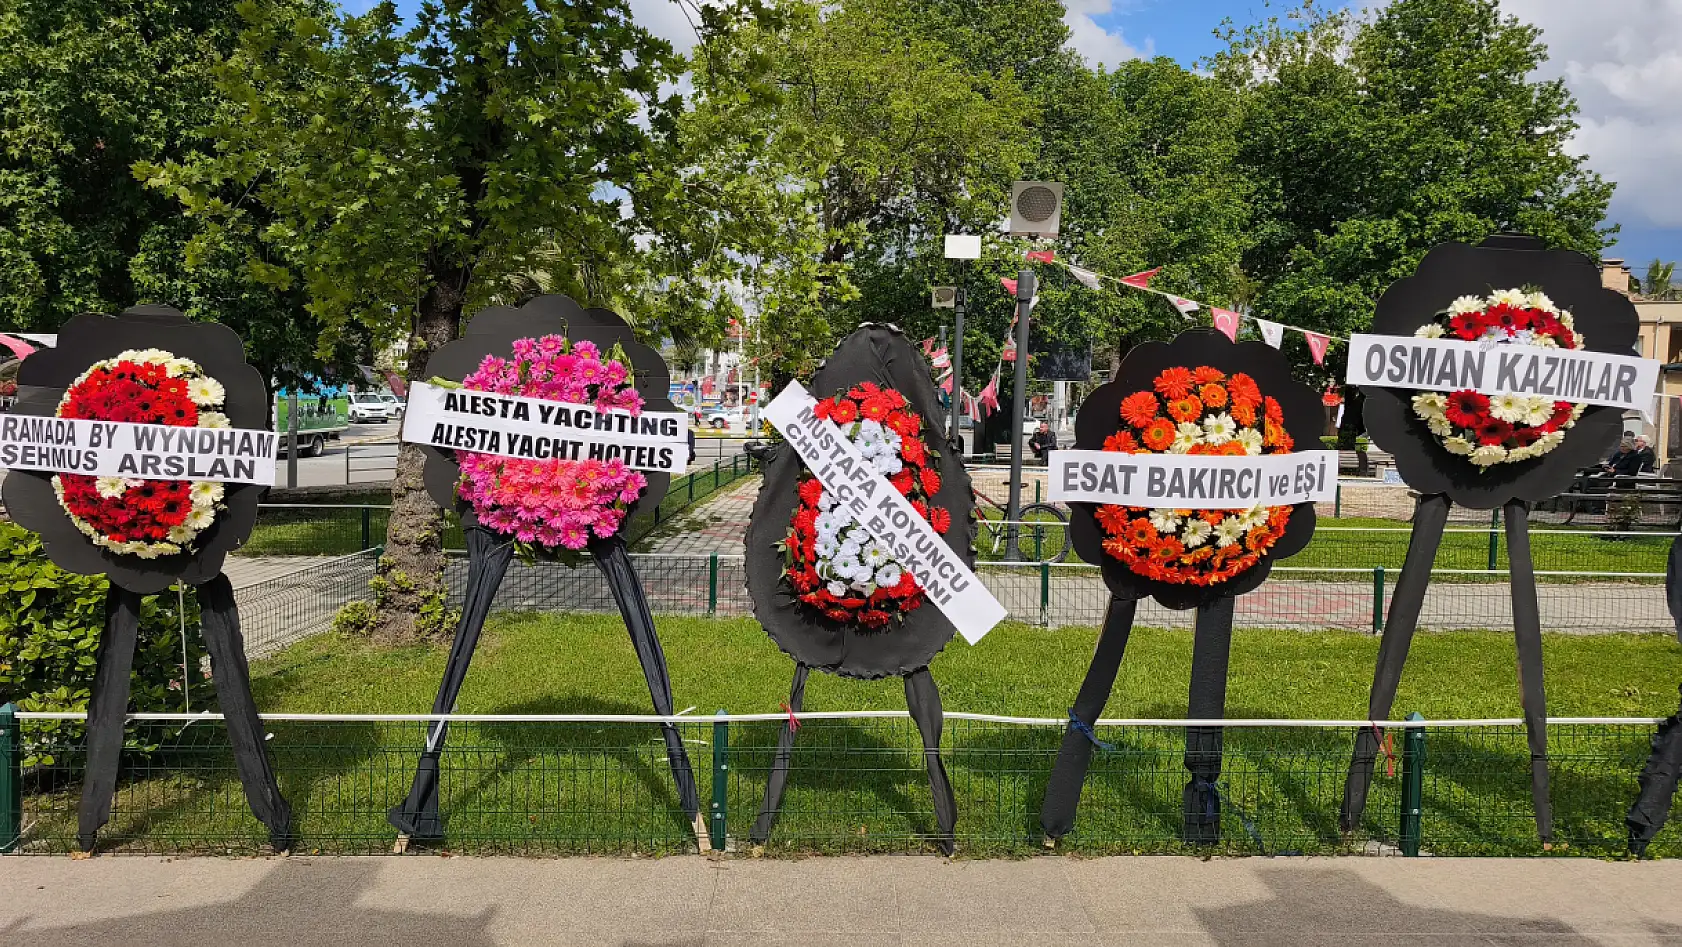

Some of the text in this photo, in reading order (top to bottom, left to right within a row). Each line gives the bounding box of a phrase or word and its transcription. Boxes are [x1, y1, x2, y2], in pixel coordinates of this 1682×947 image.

[1365, 344, 1637, 403] OSMAN KAZIMLAR
[444, 393, 678, 436] ALESTA YACHTING
[2, 417, 275, 459] RAMADA BY WYNDHAM
[431, 423, 674, 469] ALESTA YACHT HOTELS
[118, 453, 255, 479] ARSLAN
[1063, 456, 1327, 500] ESAT BAKIRCI ve EŞİ
[785, 423, 952, 606] CHP İLÇE BAŞKANI
[796, 406, 970, 593] MUSTAFA KOYUNCU
